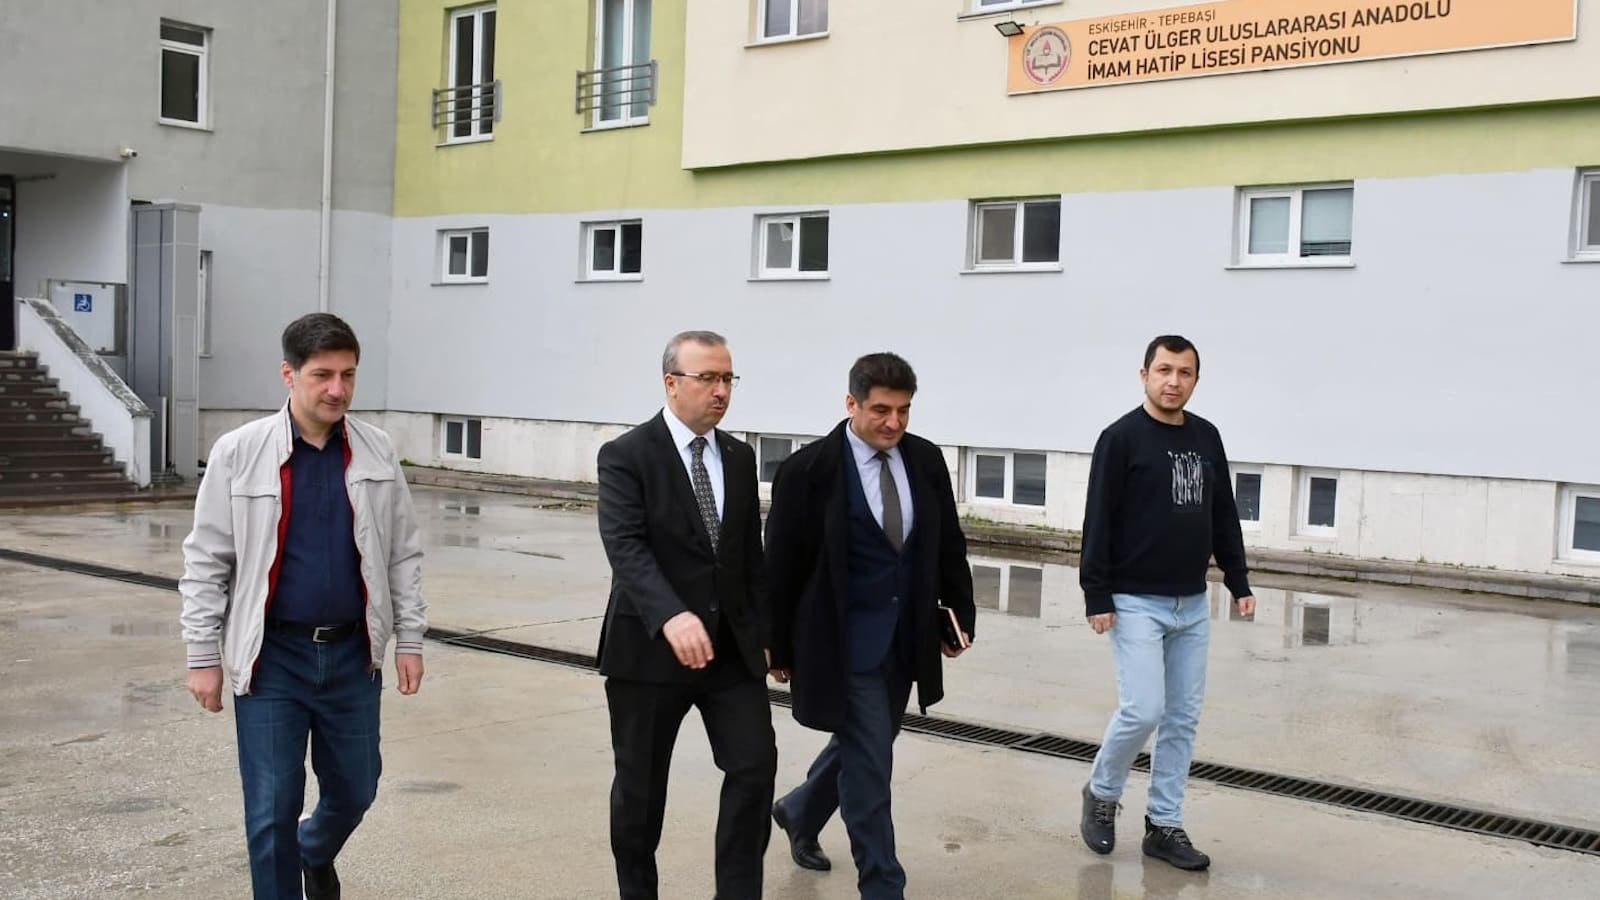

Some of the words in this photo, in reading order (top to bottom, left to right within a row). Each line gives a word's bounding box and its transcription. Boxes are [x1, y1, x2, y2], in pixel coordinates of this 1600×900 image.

[1088, 16, 1147, 35] ESKİŞEHİR
[1158, 10, 1216, 27] TEPEBAŞI
[1088, 35, 1140, 56] CEVAT
[1145, 28, 1201, 50] ÜLGER
[1206, 11, 1346, 43] ULUSLARARASI
[1351, 0, 1451, 28] ANADOLU
[1087, 60, 1131, 80] İMAM
[1136, 51, 1186, 75] HATİP
[1192, 43, 1246, 69] LİSESİ
[1251, 35, 1361, 64] PANSİYONU
